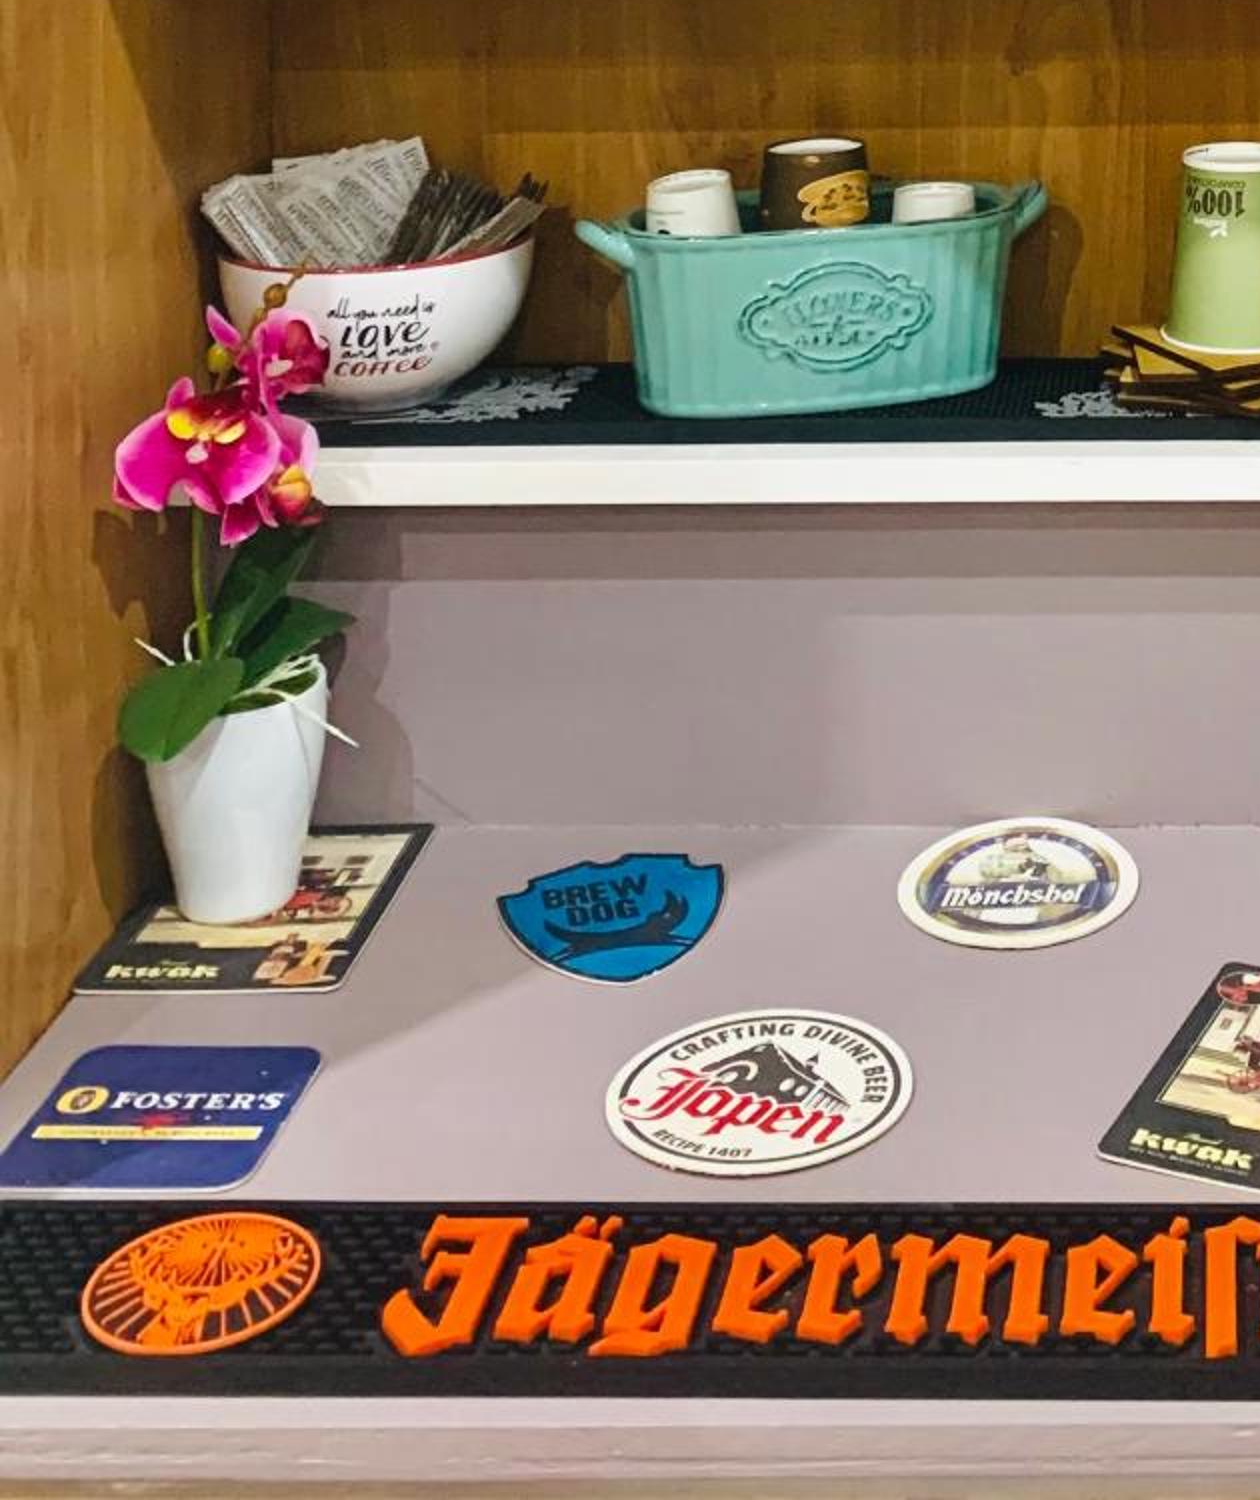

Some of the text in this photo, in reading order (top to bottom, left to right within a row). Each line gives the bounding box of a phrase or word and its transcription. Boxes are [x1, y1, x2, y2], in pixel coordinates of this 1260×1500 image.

[1185, 185, 1246, 218] 100%
[327, 296, 351, 319] all
[353, 309, 378, 333] you
[381, 293, 419, 321] need
[341, 343, 379, 360] and
[541, 873, 648, 911] BREW
[565, 899, 641, 927] DOG
[670, 1022, 888, 1104] CRAFTING DIVINE BEER
[110, 1091, 286, 1111] FOSTER'S
[618, 1066, 845, 1144] Jopen
[652, 1129, 753, 1158] RECIPE 1407
